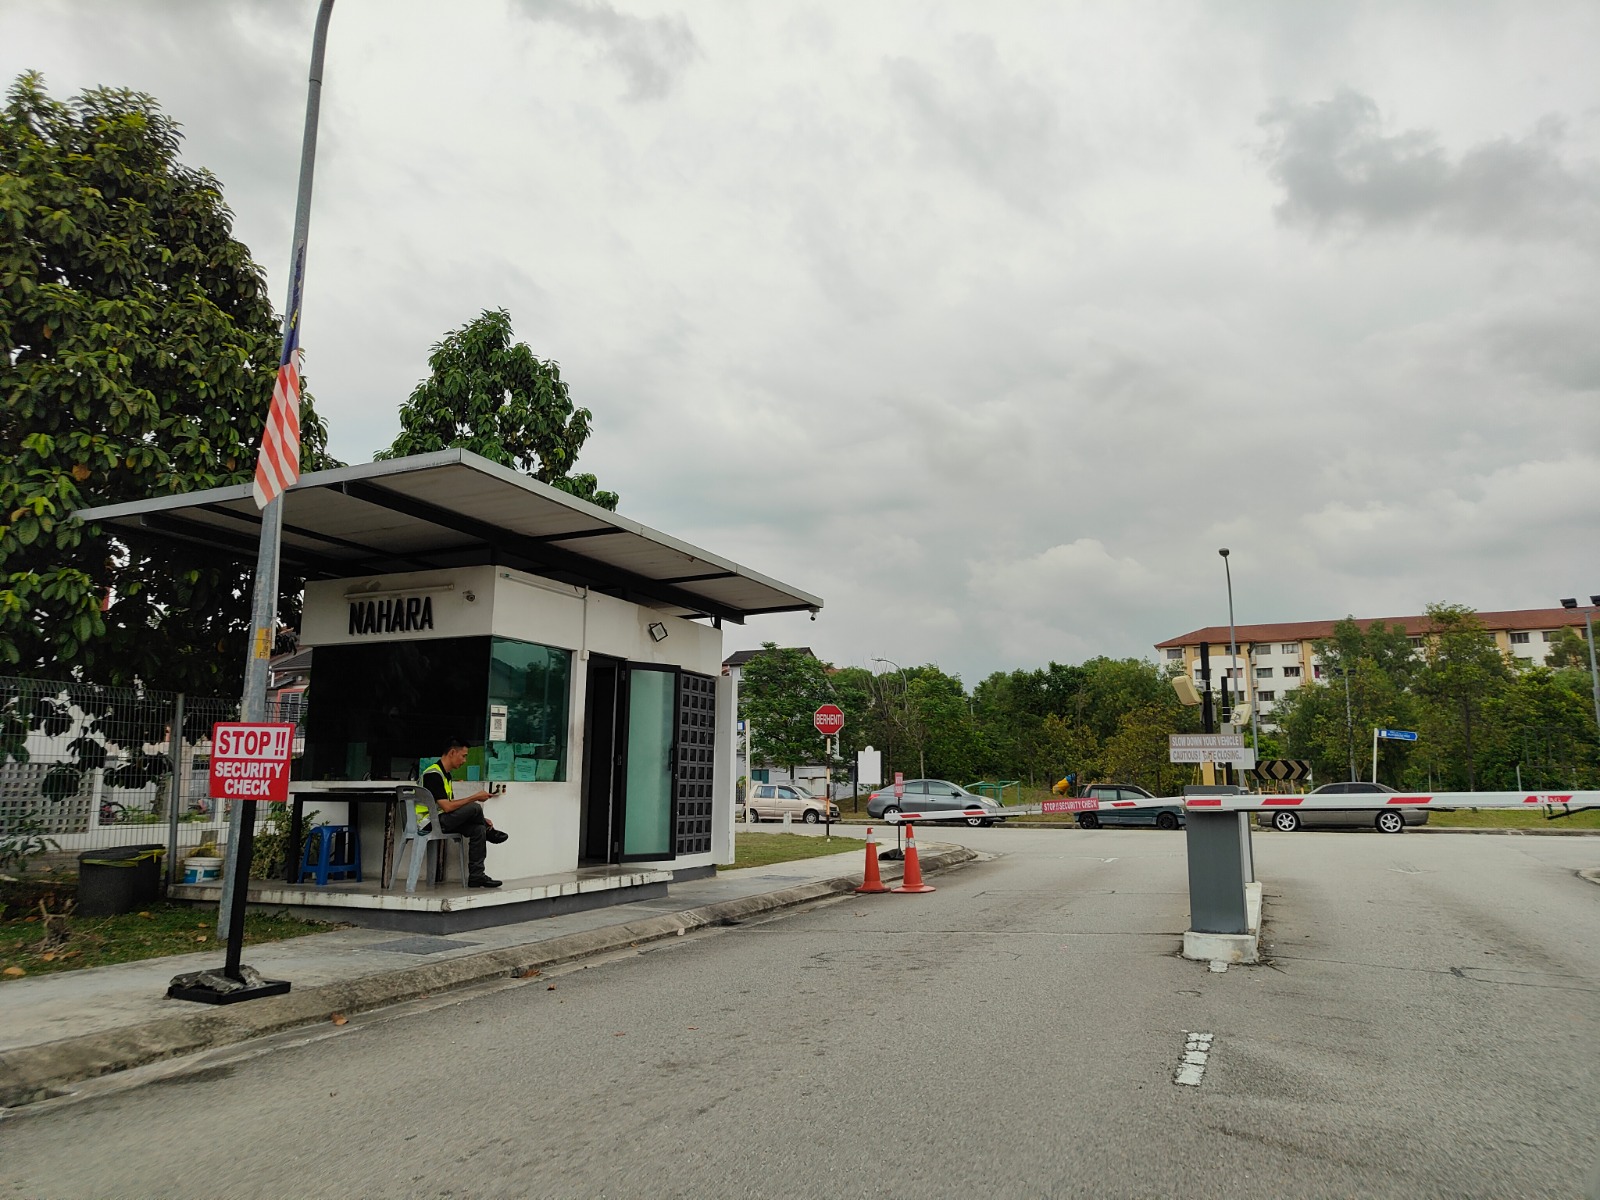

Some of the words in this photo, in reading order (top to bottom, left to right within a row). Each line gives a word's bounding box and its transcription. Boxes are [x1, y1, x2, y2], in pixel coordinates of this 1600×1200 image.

[348, 596, 434, 635] NAHARA
[816, 713, 842, 725] BERHENTI
[1171, 736, 1186, 747] SLOW
[1186, 736, 1202, 747] DOWN
[1202, 736, 1217, 746] YOUR
[215, 761, 284, 779] SECURITY
[224, 778, 271, 796] CHECK
[1059, 801, 1081, 811] SECURITY
[1081, 799, 1097, 809] CHECK
